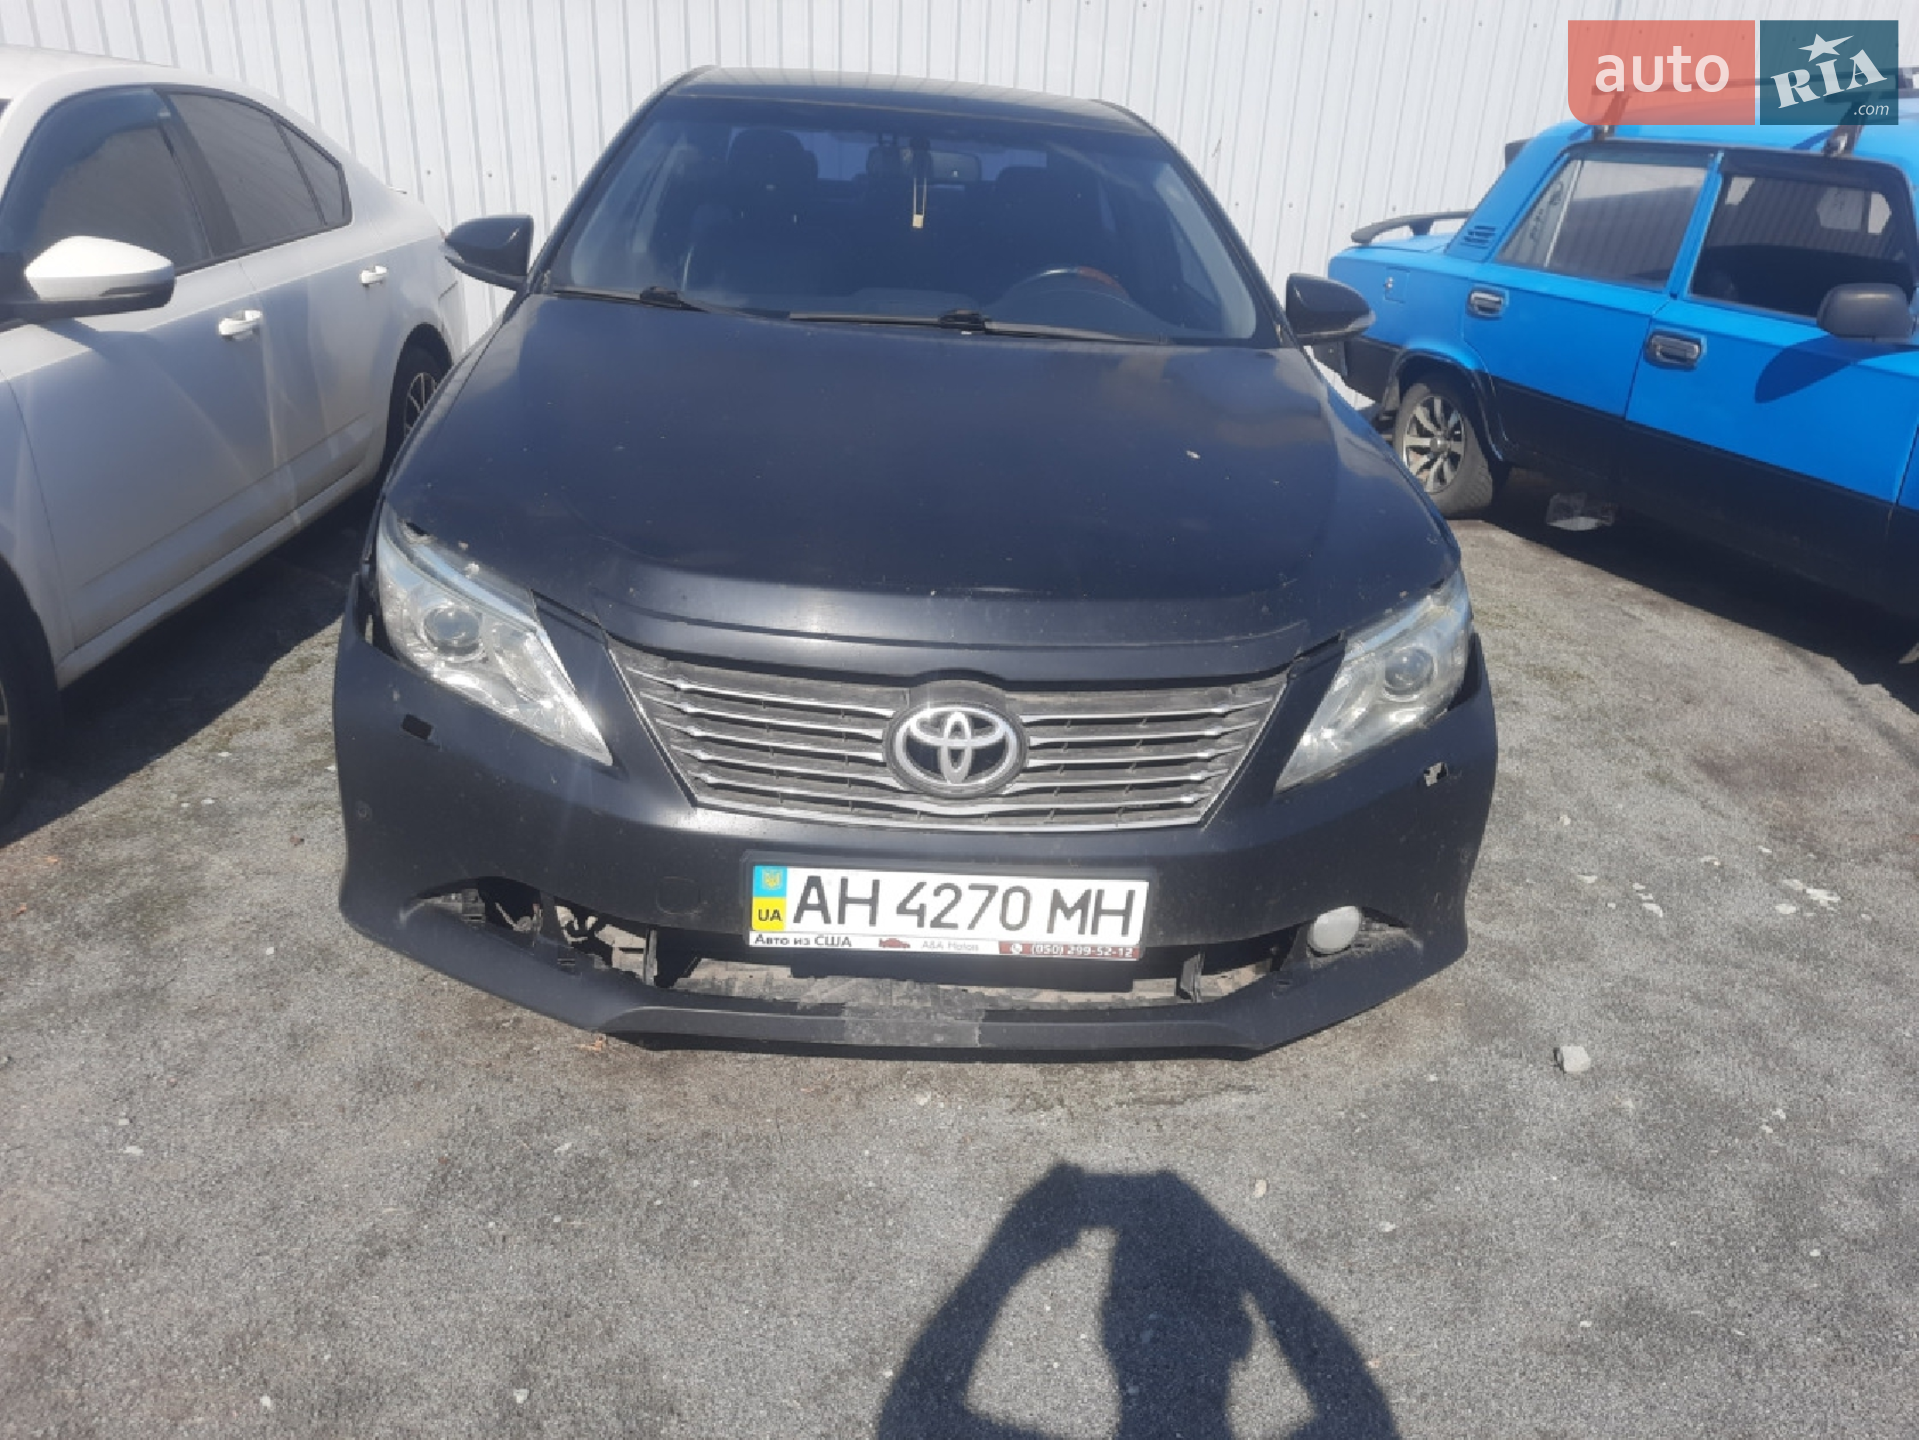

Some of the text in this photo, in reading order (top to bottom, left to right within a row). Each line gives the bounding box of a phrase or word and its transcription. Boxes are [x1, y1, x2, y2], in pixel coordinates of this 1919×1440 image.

[793, 875, 1136, 936] AH 4270 MH
[758, 908, 783, 922] UA
[754, 933, 852, 947] Авто из США
[1031, 944, 1064, 956] (050)
